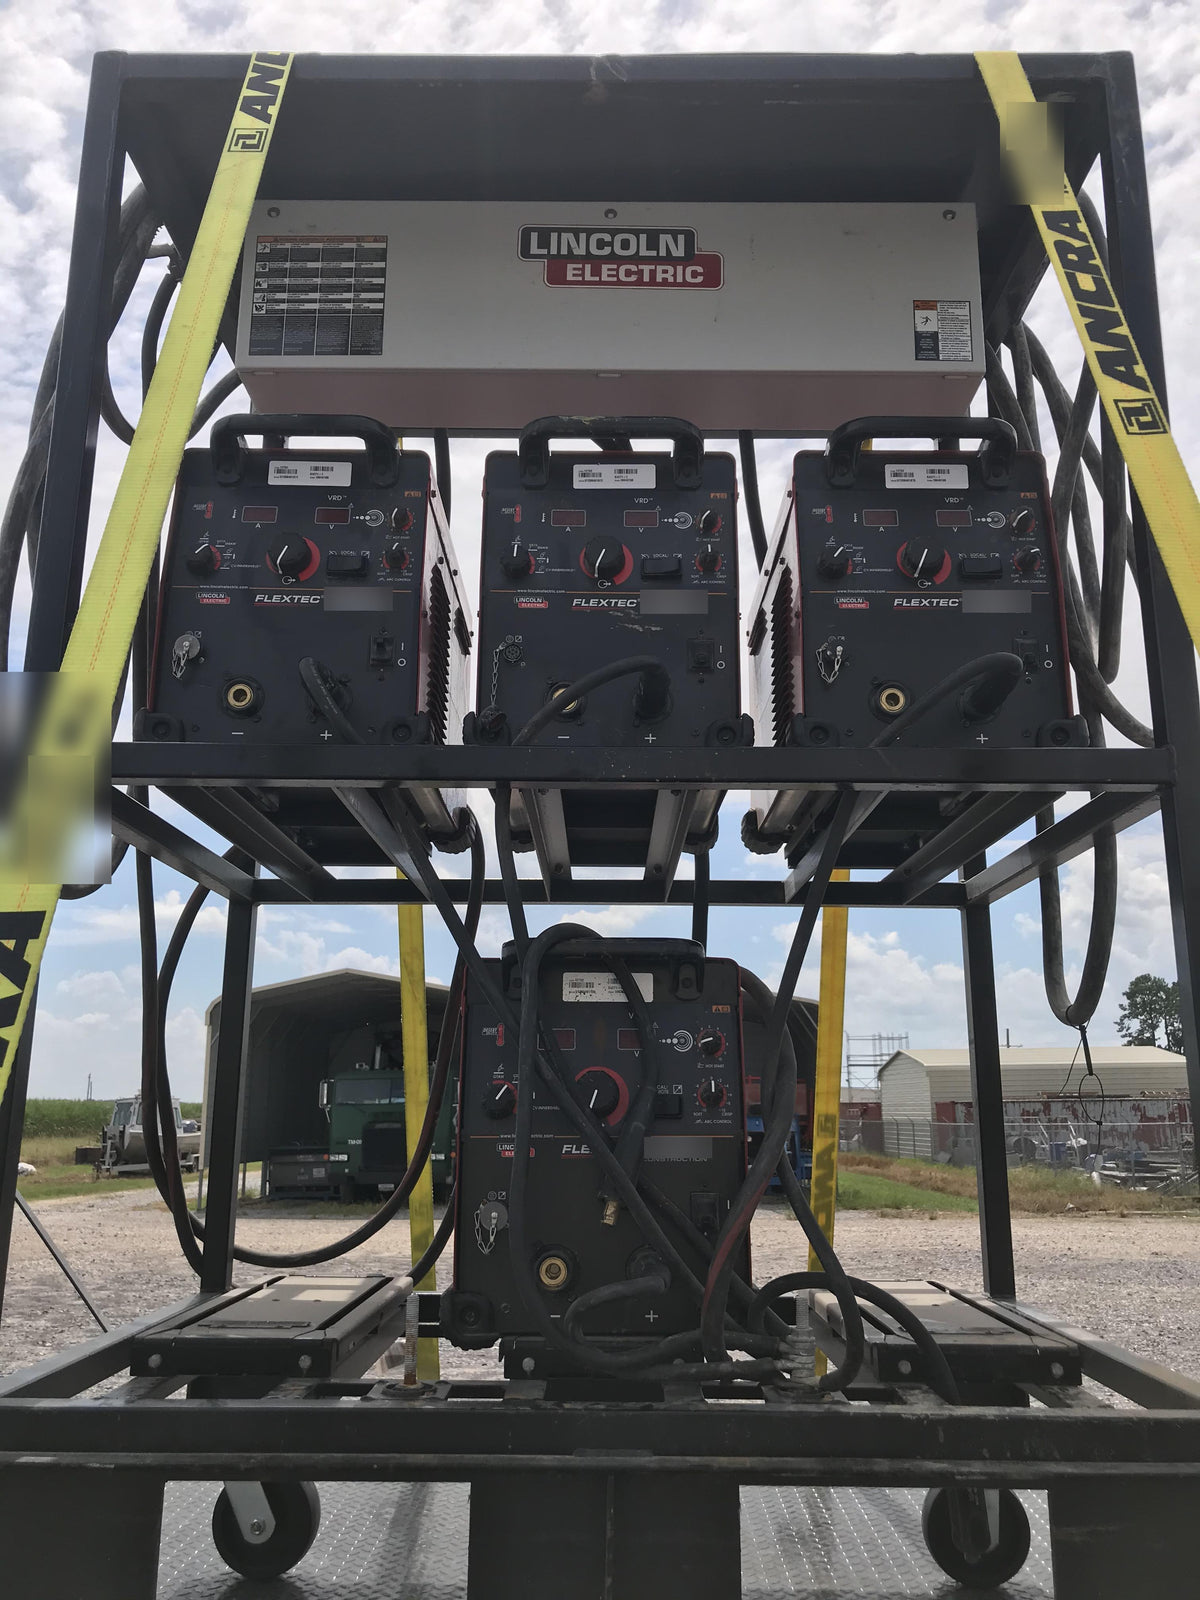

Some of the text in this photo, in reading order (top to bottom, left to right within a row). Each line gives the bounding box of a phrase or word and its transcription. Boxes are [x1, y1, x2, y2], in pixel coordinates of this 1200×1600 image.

[529, 231, 686, 257] LINCOLN
[565, 263, 705, 284] ELECTRIC
[1041, 209, 1151, 393] ANCRA
[254, 594, 321, 604] FLEXTEC
[572, 598, 638, 608] FLEXTEC
[893, 598, 960, 608] FLEXTEC
